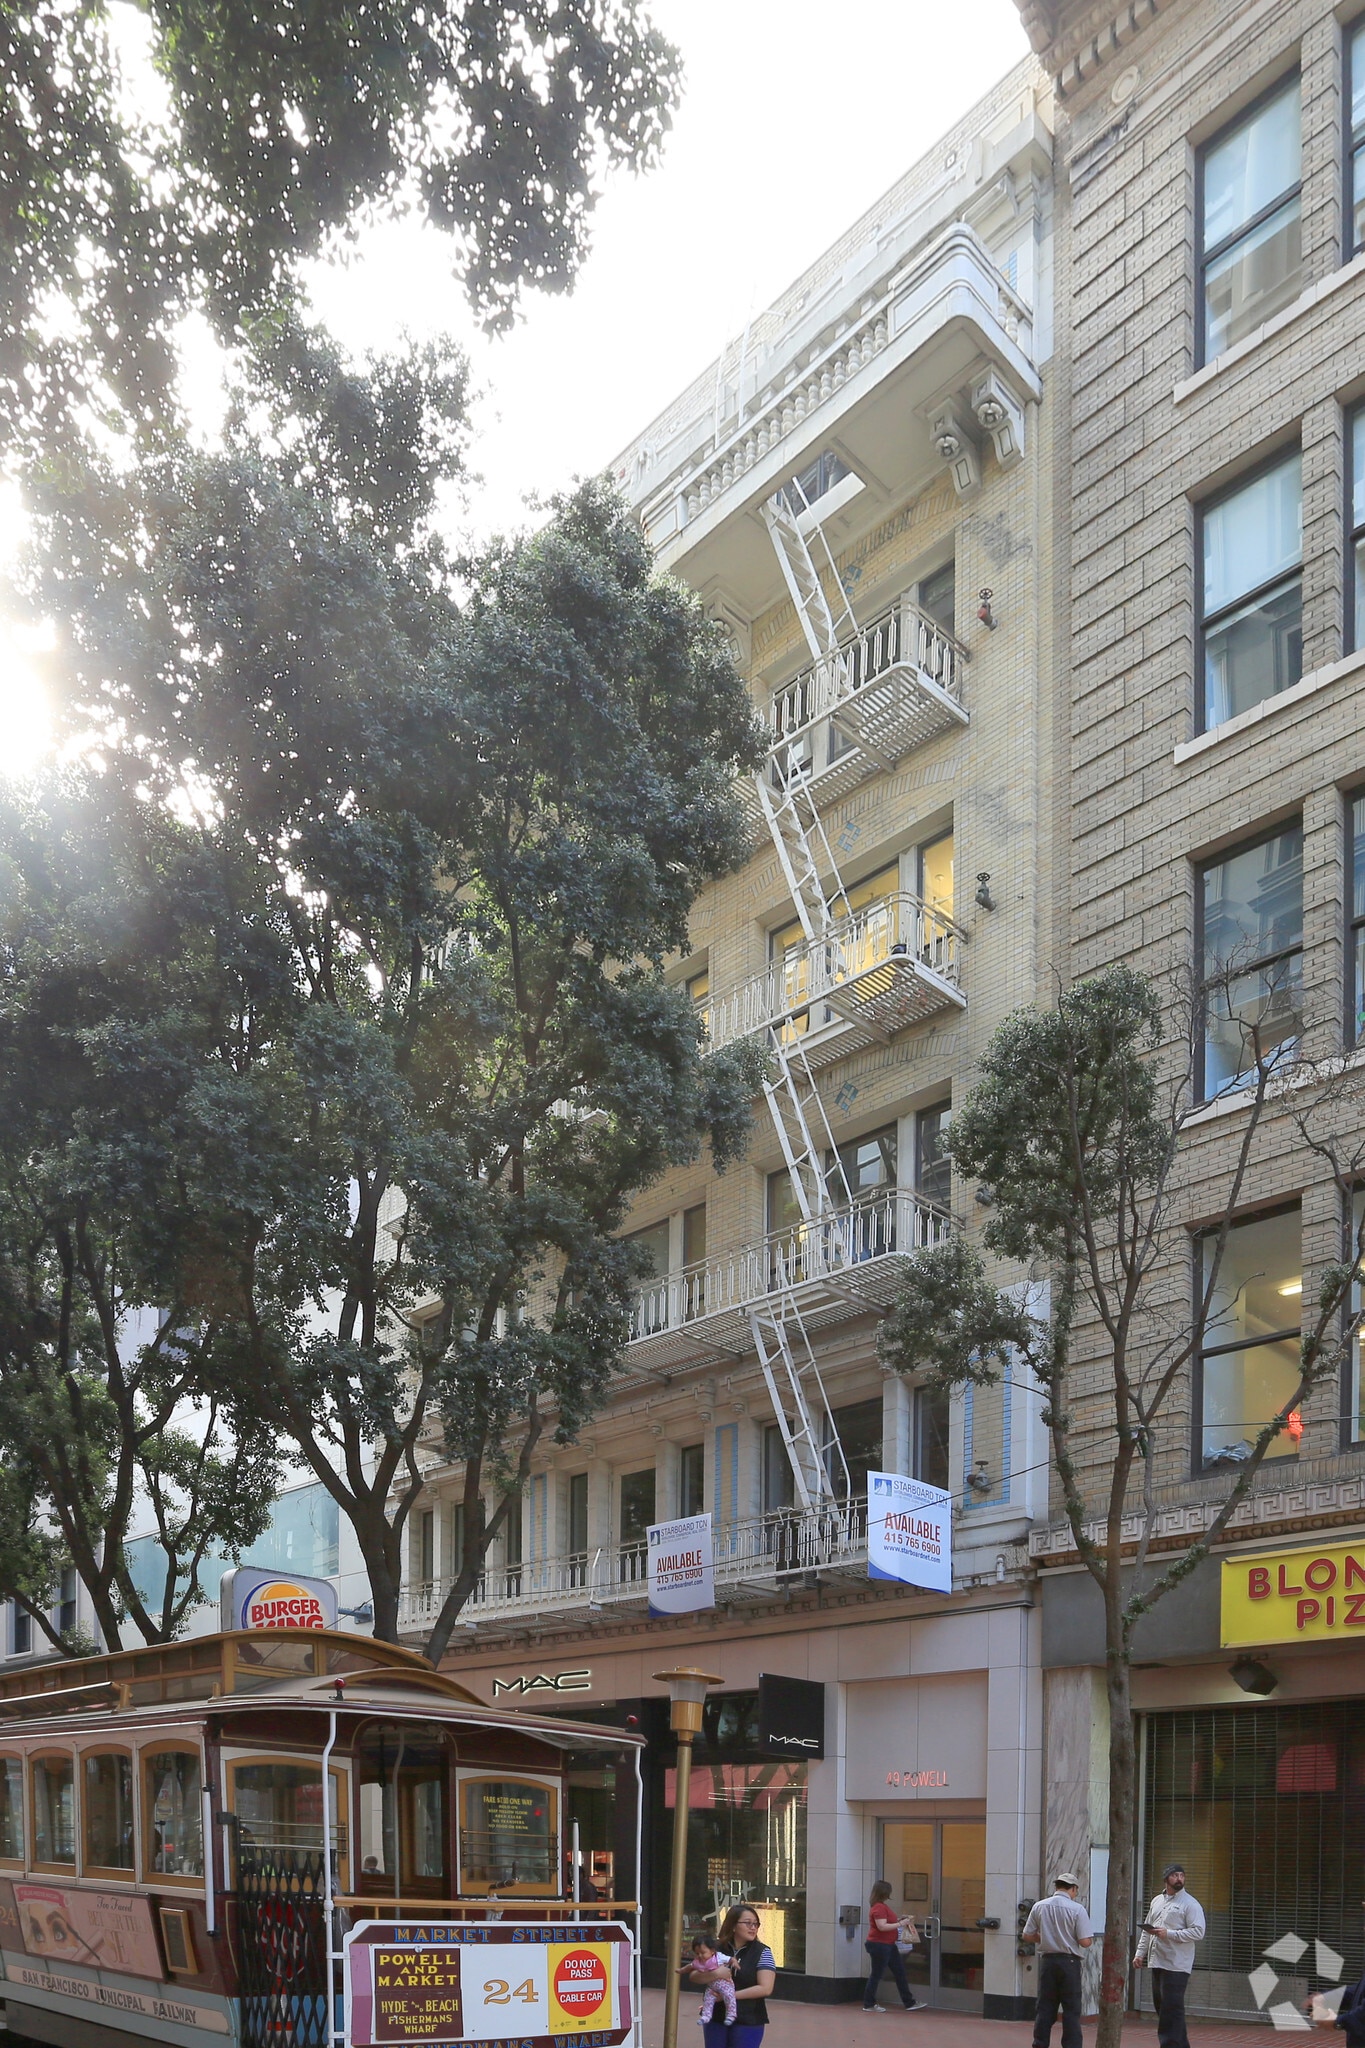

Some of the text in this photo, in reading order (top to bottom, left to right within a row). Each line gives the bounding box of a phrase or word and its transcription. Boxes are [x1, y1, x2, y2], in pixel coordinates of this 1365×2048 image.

[894, 1480, 934, 1500] STARBOARD
[660, 1519, 708, 1537] STARBOARD TCN
[884, 1512, 941, 1543] AVAILABLE
[884, 1532, 941, 1556] 415 765 6900
[656, 1550, 702, 1574] AVAILABLE
[884, 1544, 941, 1564] www.starboardnet.com
[656, 1568, 703, 1585] 415 765 6900
[656, 1579, 703, 1592] www.starboardnet.com
[251, 1599, 321, 1623] BURGER
[886, 1770, 950, 1787] 49 POWELL
[394, 1927, 491, 1943] MARKET
[511, 1927, 590, 1942] STREET
[379, 1954, 456, 1966] POWELL
[564, 1958, 598, 1968] DO NOT
[400, 1966, 438, 1974] AND
[570, 1969, 593, 1978] PASS
[22, 1970, 39, 1987] SAN
[378, 1974, 458, 1987] MARKET
[482, 1978, 539, 2004] 24
[560, 1992, 603, 2004] CABLE CAR
[381, 2000, 408, 2014] HYDE
[425, 1999, 459, 2012] BEACH
[388, 2014, 452, 2025] FISHERMANS
[404, 2024, 438, 2034] WHARF
